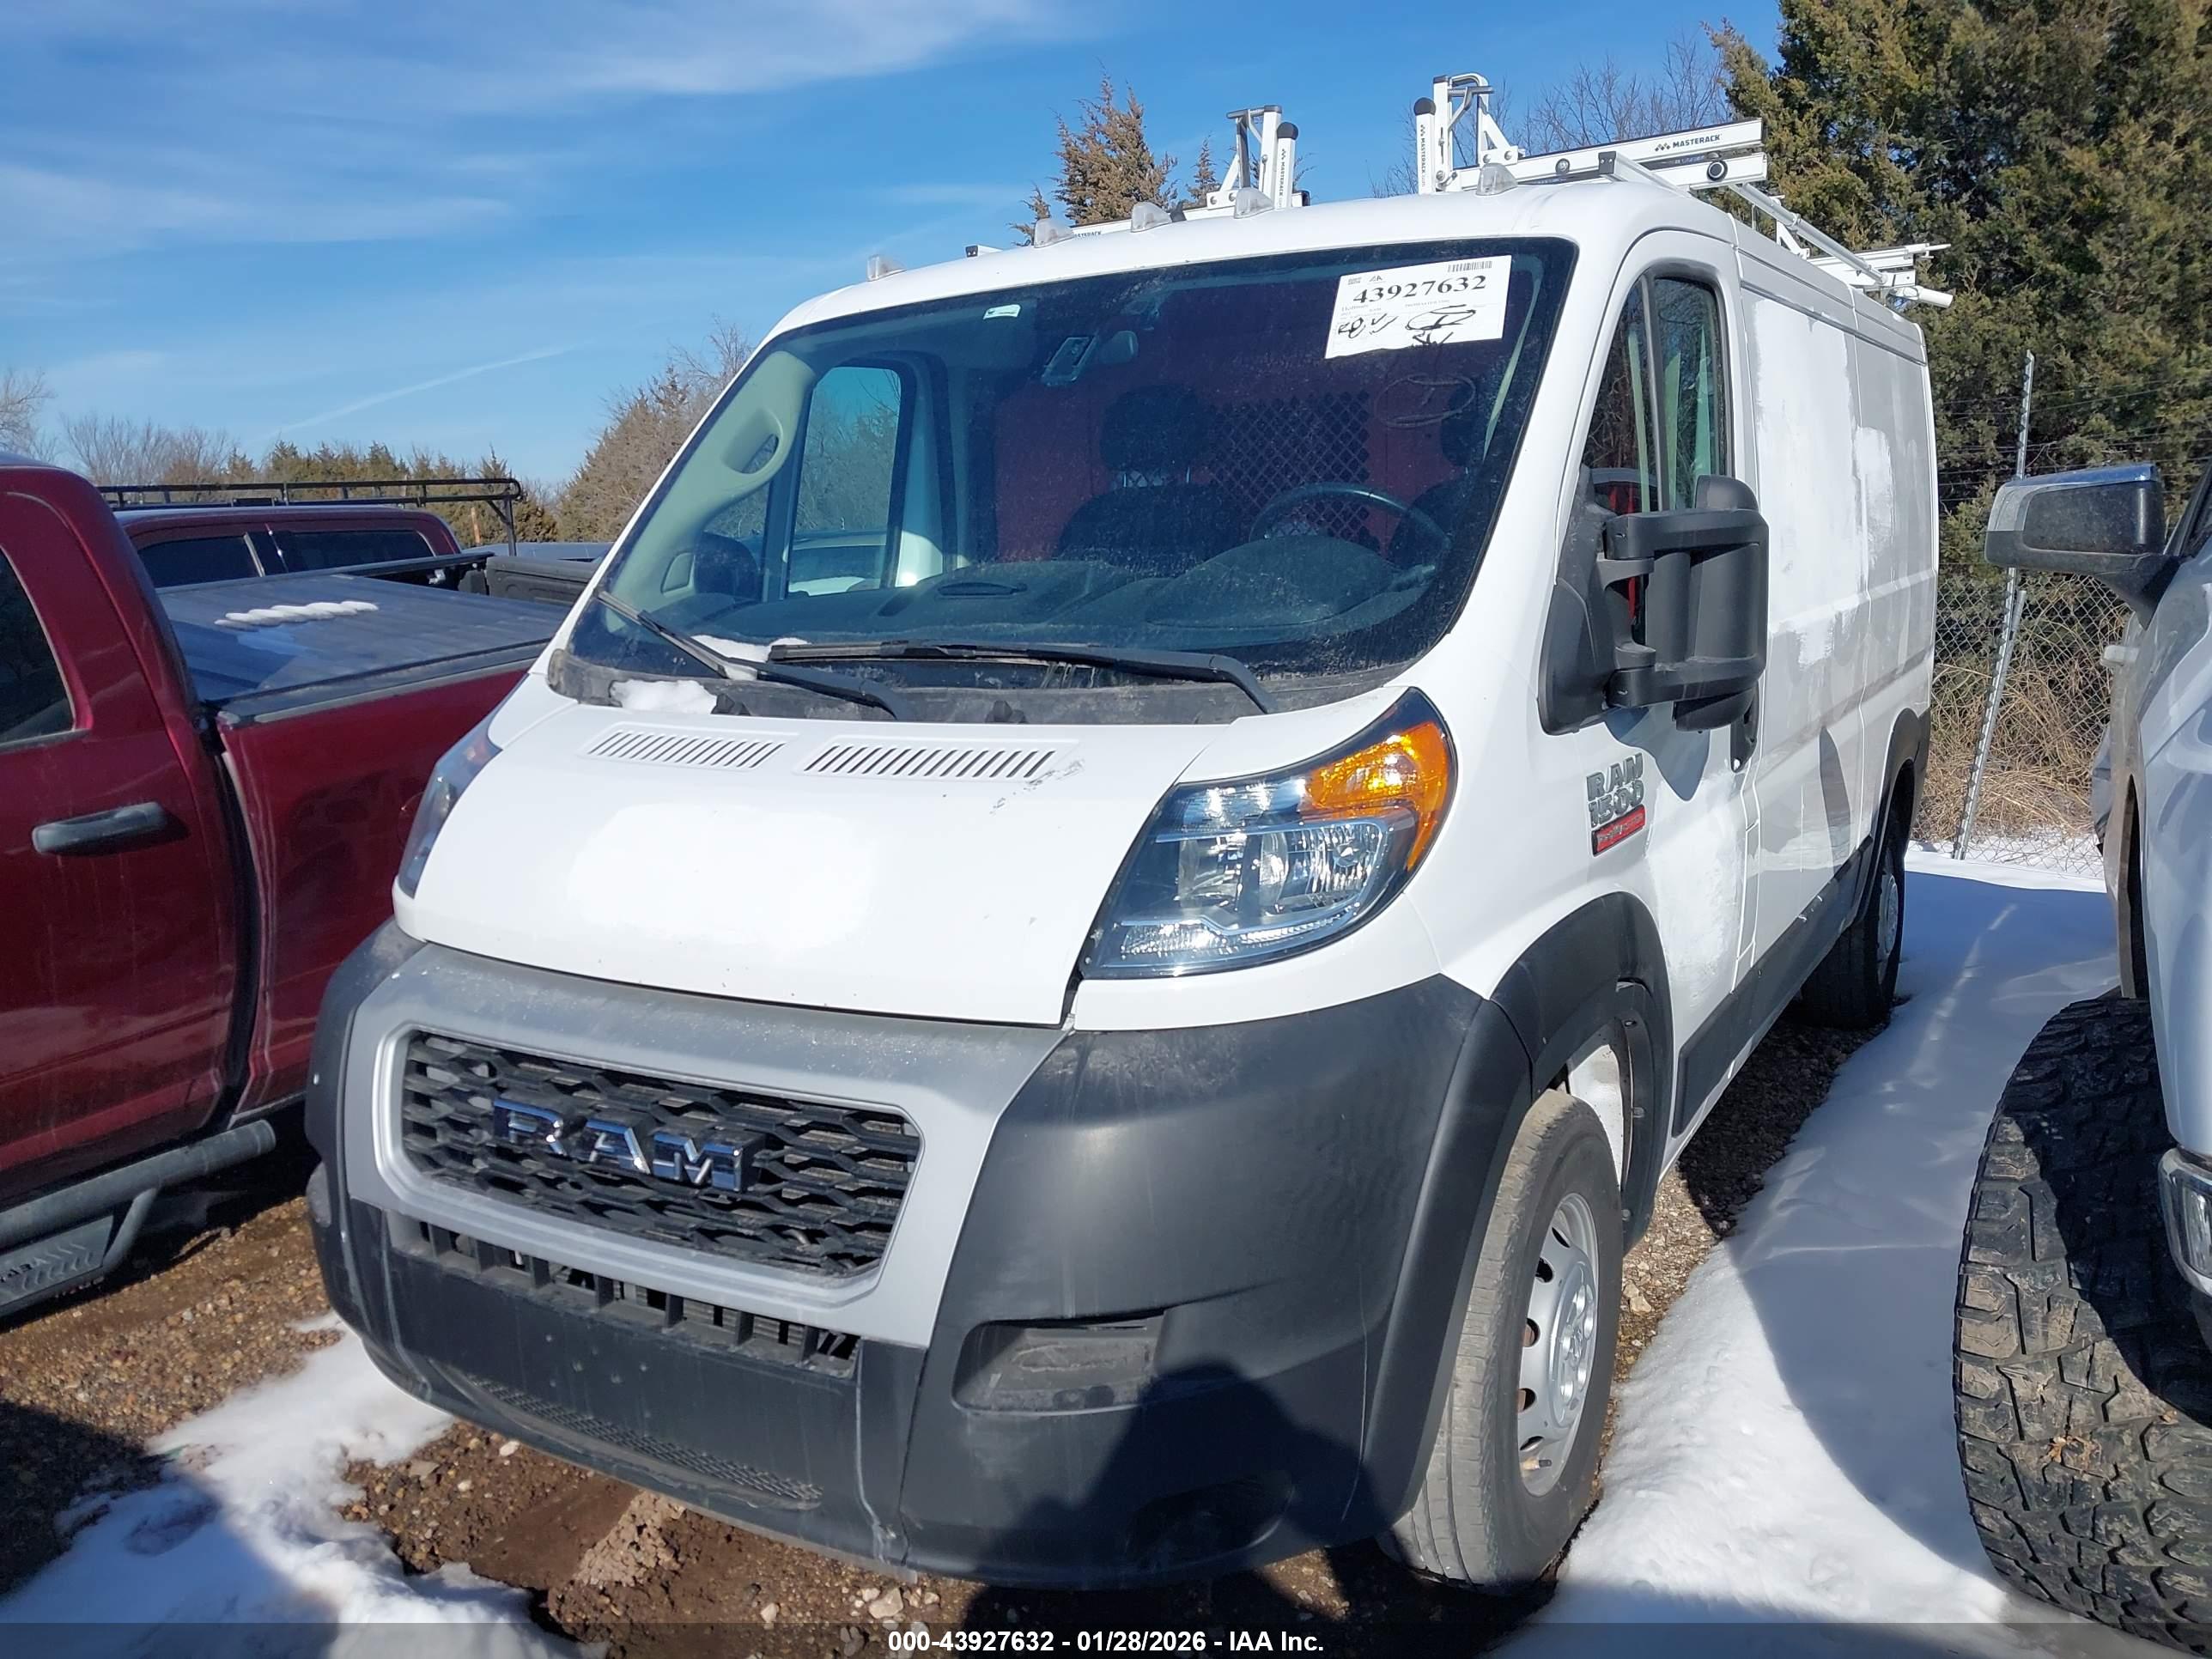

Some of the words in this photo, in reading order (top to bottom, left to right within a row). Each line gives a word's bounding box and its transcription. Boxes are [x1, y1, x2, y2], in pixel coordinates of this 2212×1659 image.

[1673, 134, 1720, 149] MASTERACK
[1352, 275, 1486, 304] 43927632
[1586, 752, 1644, 802] RAM
[1588, 779, 1644, 829] 1500
[493, 1098, 744, 1193] RAM
